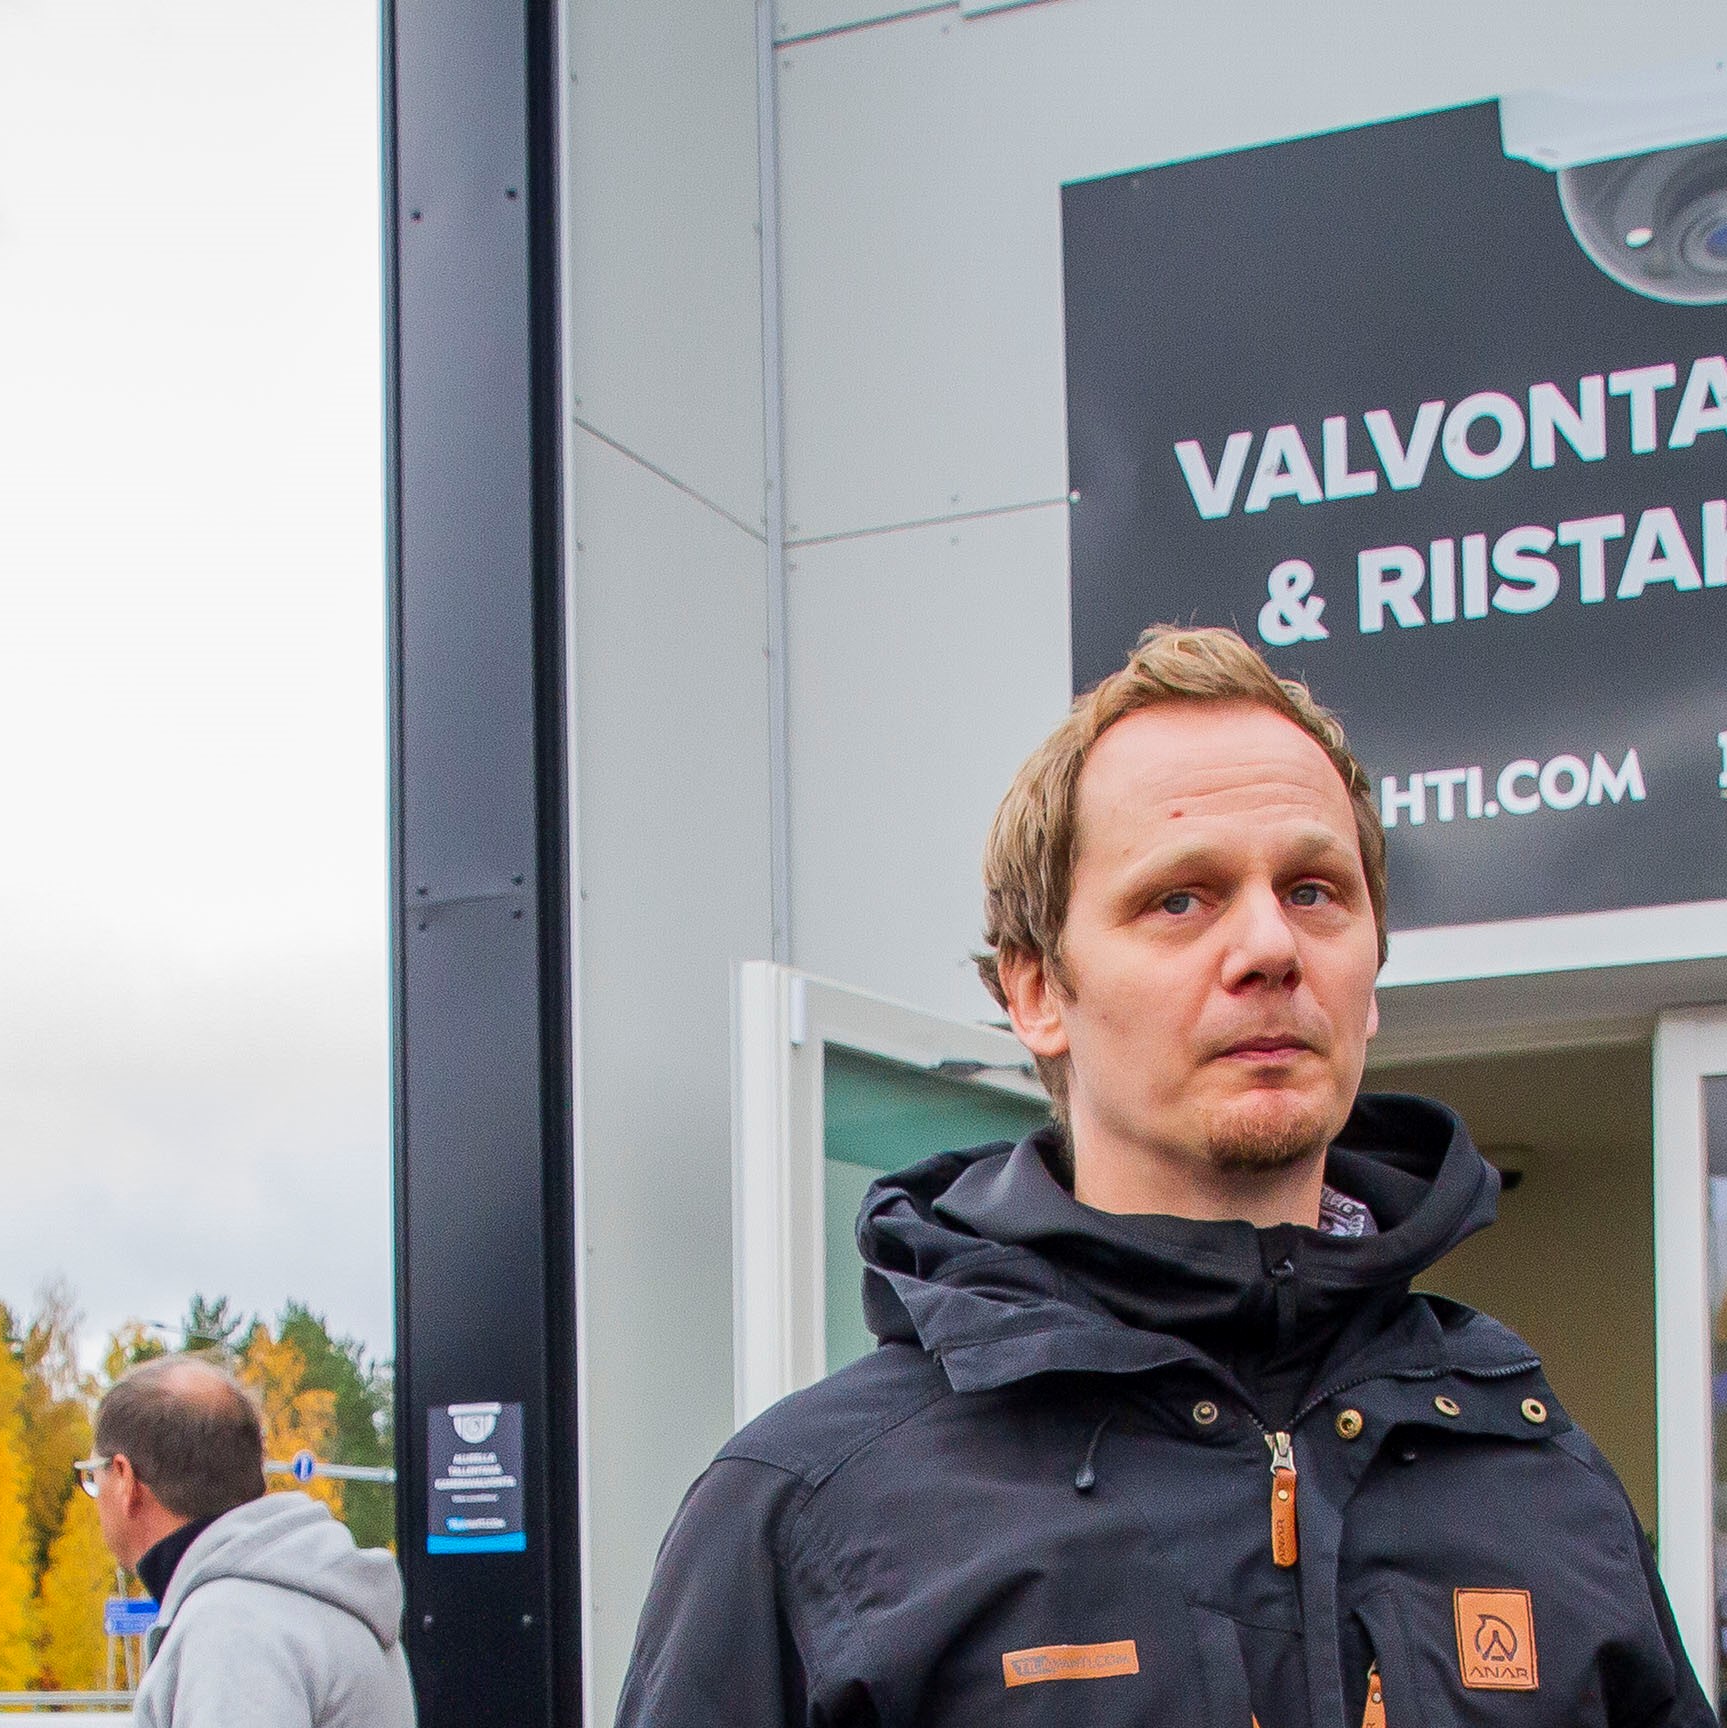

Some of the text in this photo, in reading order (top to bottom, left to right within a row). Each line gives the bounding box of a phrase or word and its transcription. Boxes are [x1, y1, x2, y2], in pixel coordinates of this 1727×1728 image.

[1257, 558, 1330, 647] &
[1380, 747, 1647, 829] HTI.COM
[1470, 1666, 1529, 1680] ANAR
